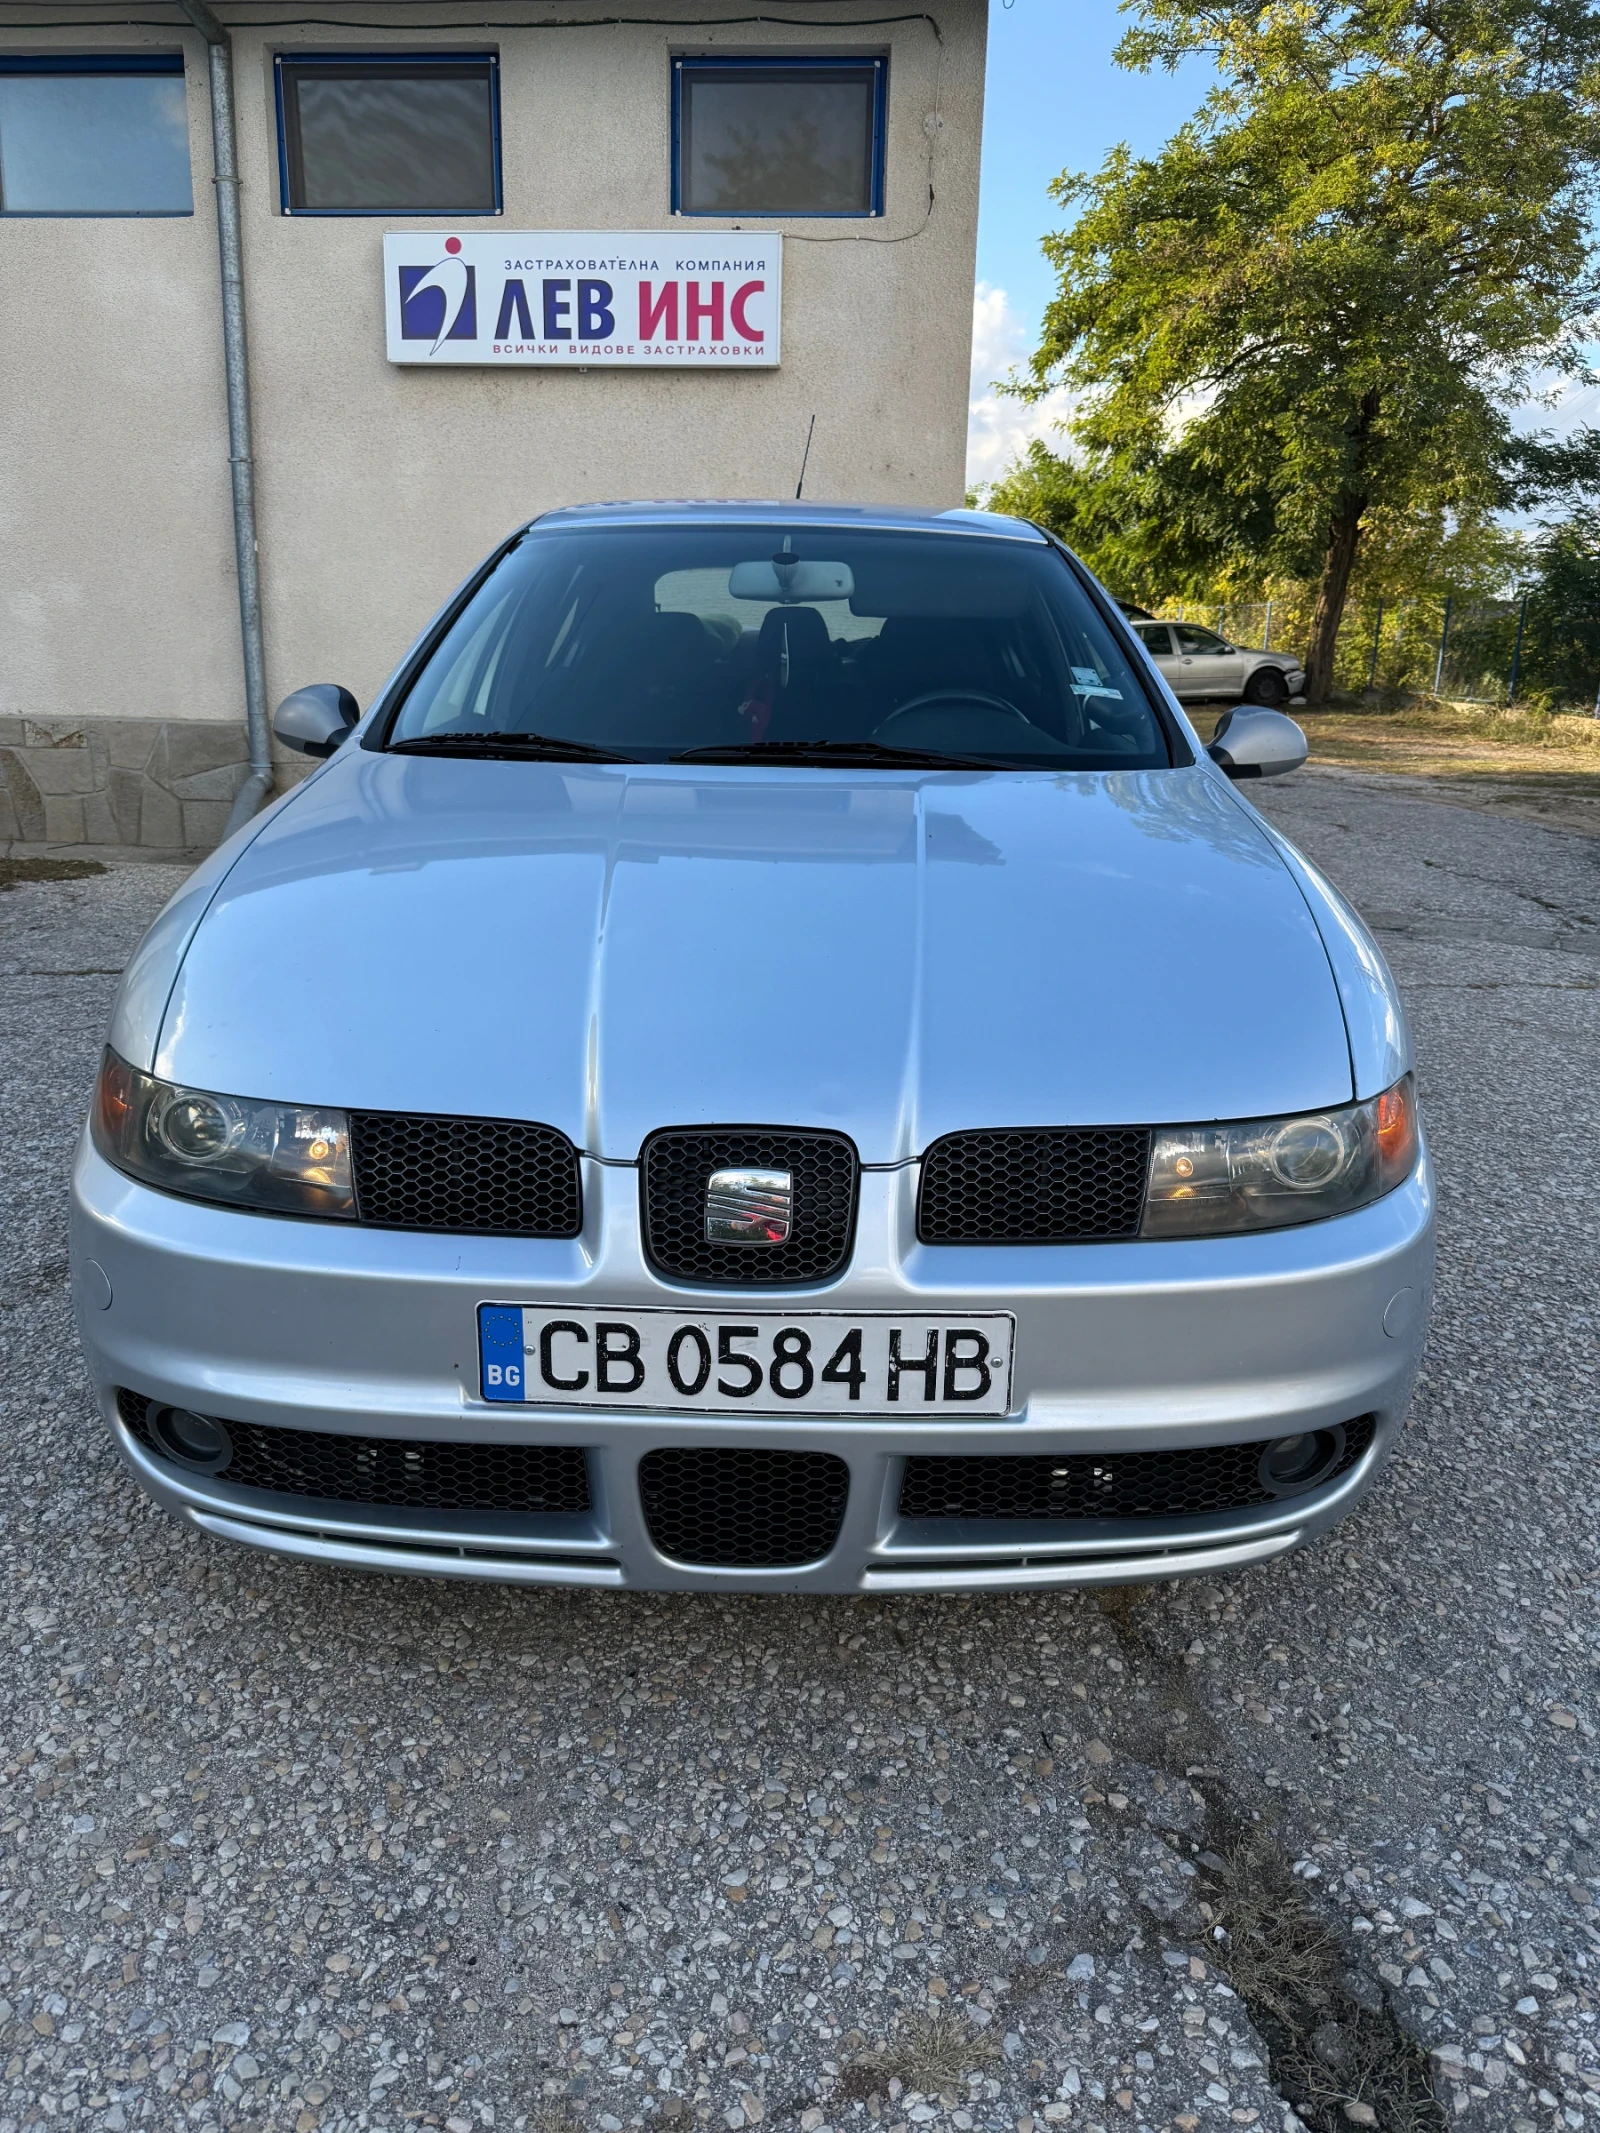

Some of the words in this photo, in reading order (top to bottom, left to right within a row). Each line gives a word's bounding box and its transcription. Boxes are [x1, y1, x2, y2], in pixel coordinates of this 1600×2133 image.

[504, 259, 660, 271] ЗАСТРАХОВАТЕЛНА
[676, 260, 767, 271] КОМПАНИЯ
[494, 279, 616, 340] ЛЕВ
[638, 280, 765, 342] ИНС
[493, 344, 559, 354] ВСИЧКИ
[569, 345, 636, 355] ВИДОВЕ
[644, 345, 765, 356] ЗАСТРАХОВКИ
[539, 1319, 646, 1393] CB
[666, 1323, 867, 1400] 0584
[887, 1328, 993, 1402] HB
[487, 1364, 521, 1387] BG
